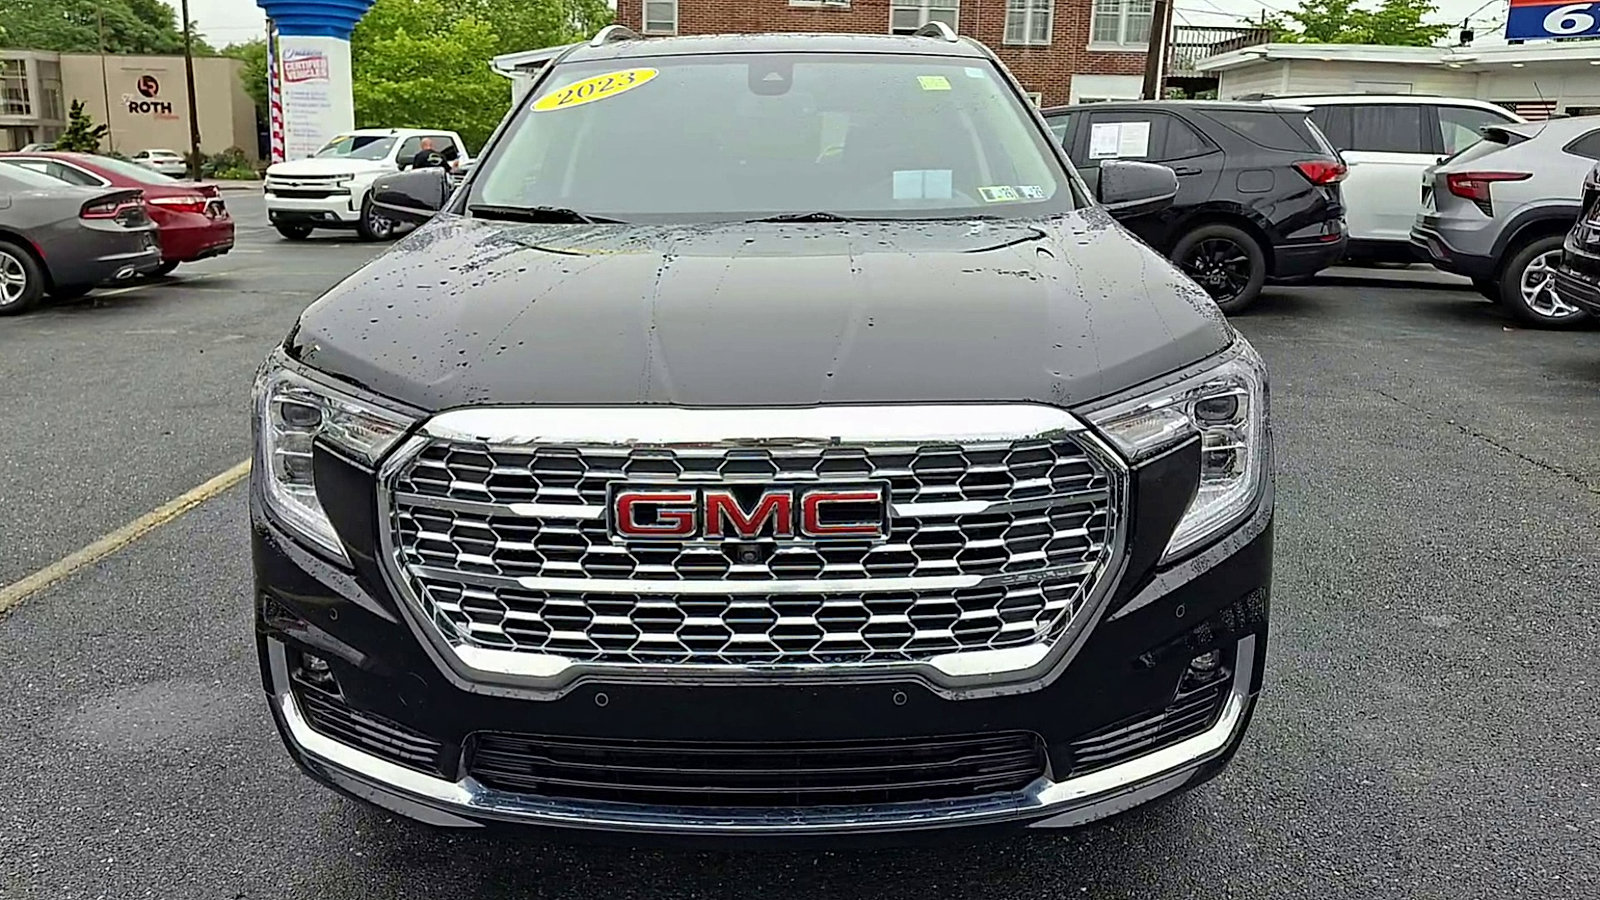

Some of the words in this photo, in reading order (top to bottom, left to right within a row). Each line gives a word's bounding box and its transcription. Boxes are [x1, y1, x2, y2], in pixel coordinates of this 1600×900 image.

[1543, 3, 1600, 34] 6
[285, 58, 327, 72] CERTIFIED
[286, 67, 328, 80] VEHICLES
[557, 72, 636, 106] 2023
[128, 100, 172, 114] ROTH
[614, 490, 884, 540] GMC
